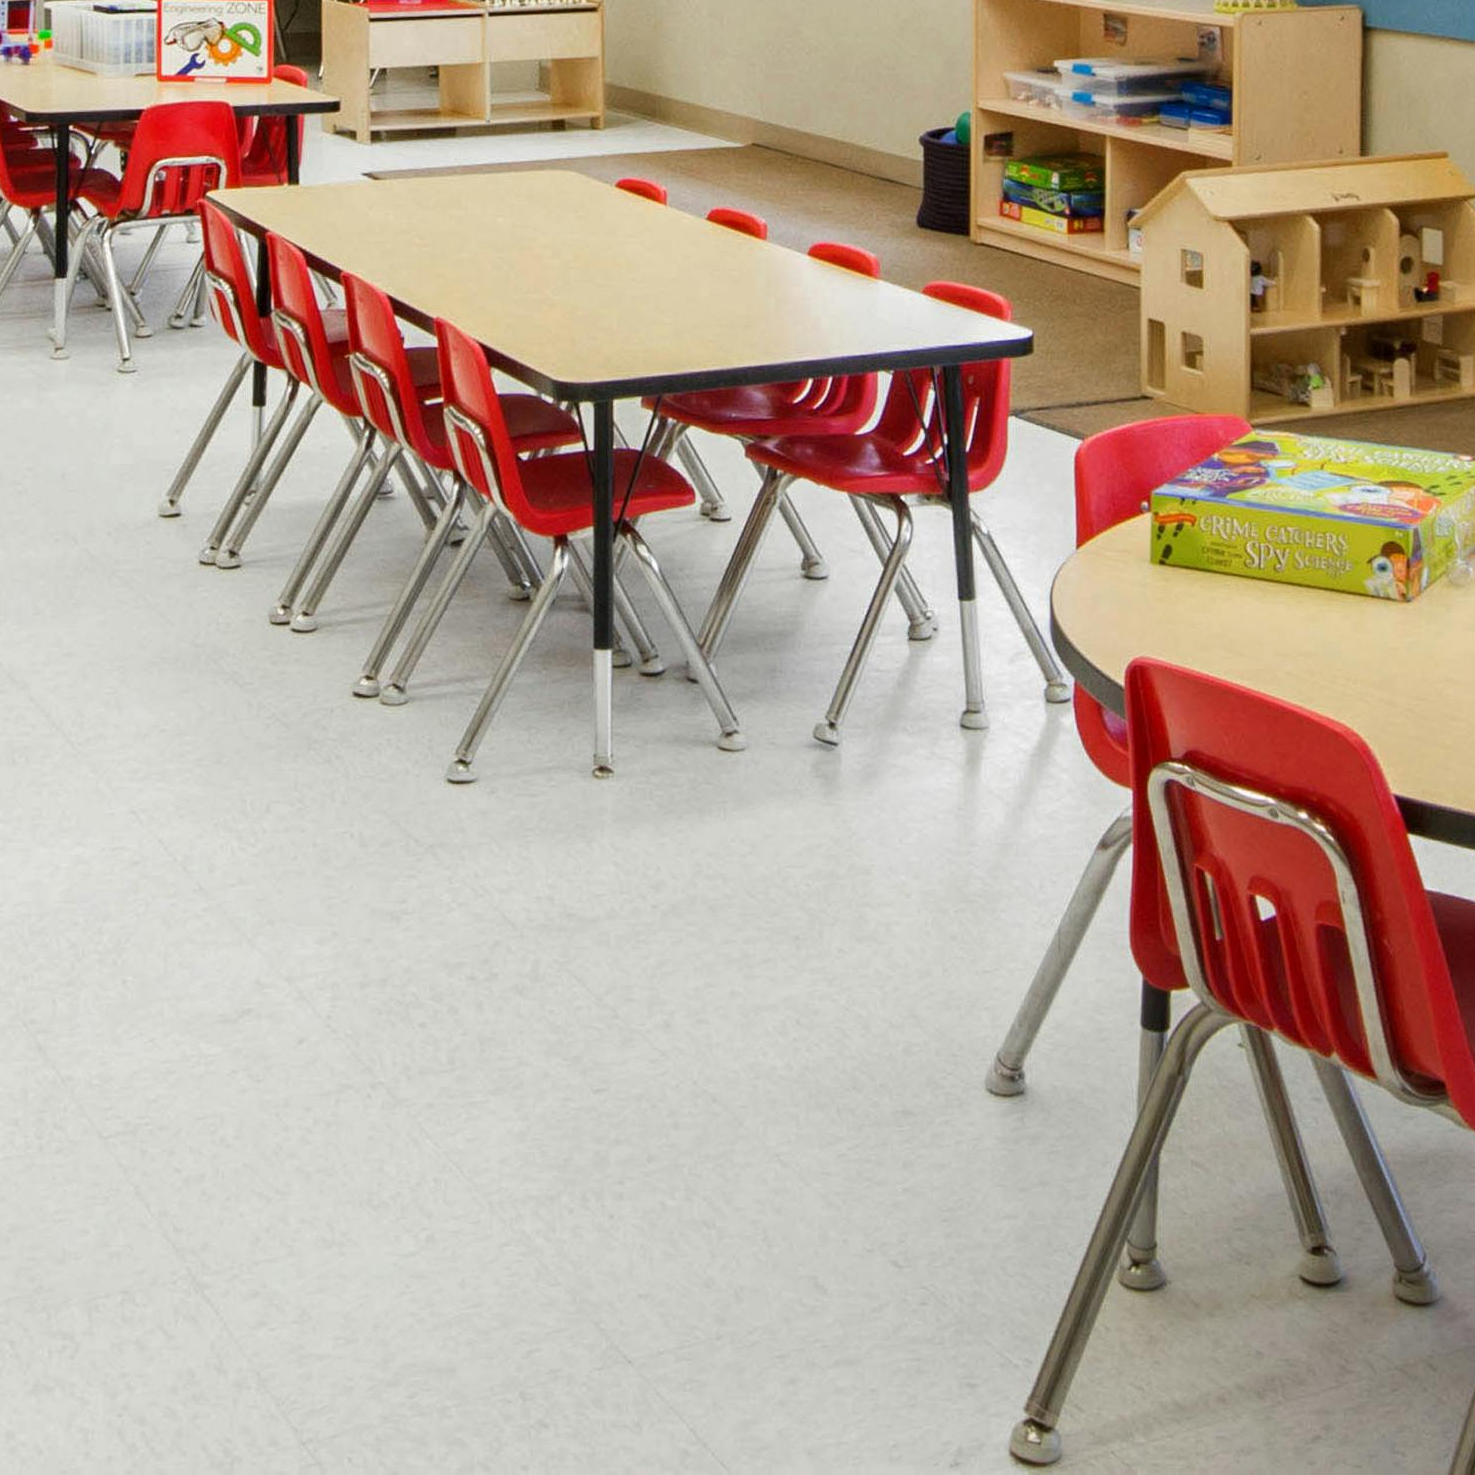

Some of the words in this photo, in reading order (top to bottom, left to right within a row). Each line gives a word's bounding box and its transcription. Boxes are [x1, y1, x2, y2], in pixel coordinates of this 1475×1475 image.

[163, 2, 224, 16] Engineering
[226, 2, 266, 15] ZONE
[1199, 514, 1260, 542] CRIME
[1265, 526, 1349, 557] CATCHERS
[1244, 540, 1291, 573] SPY
